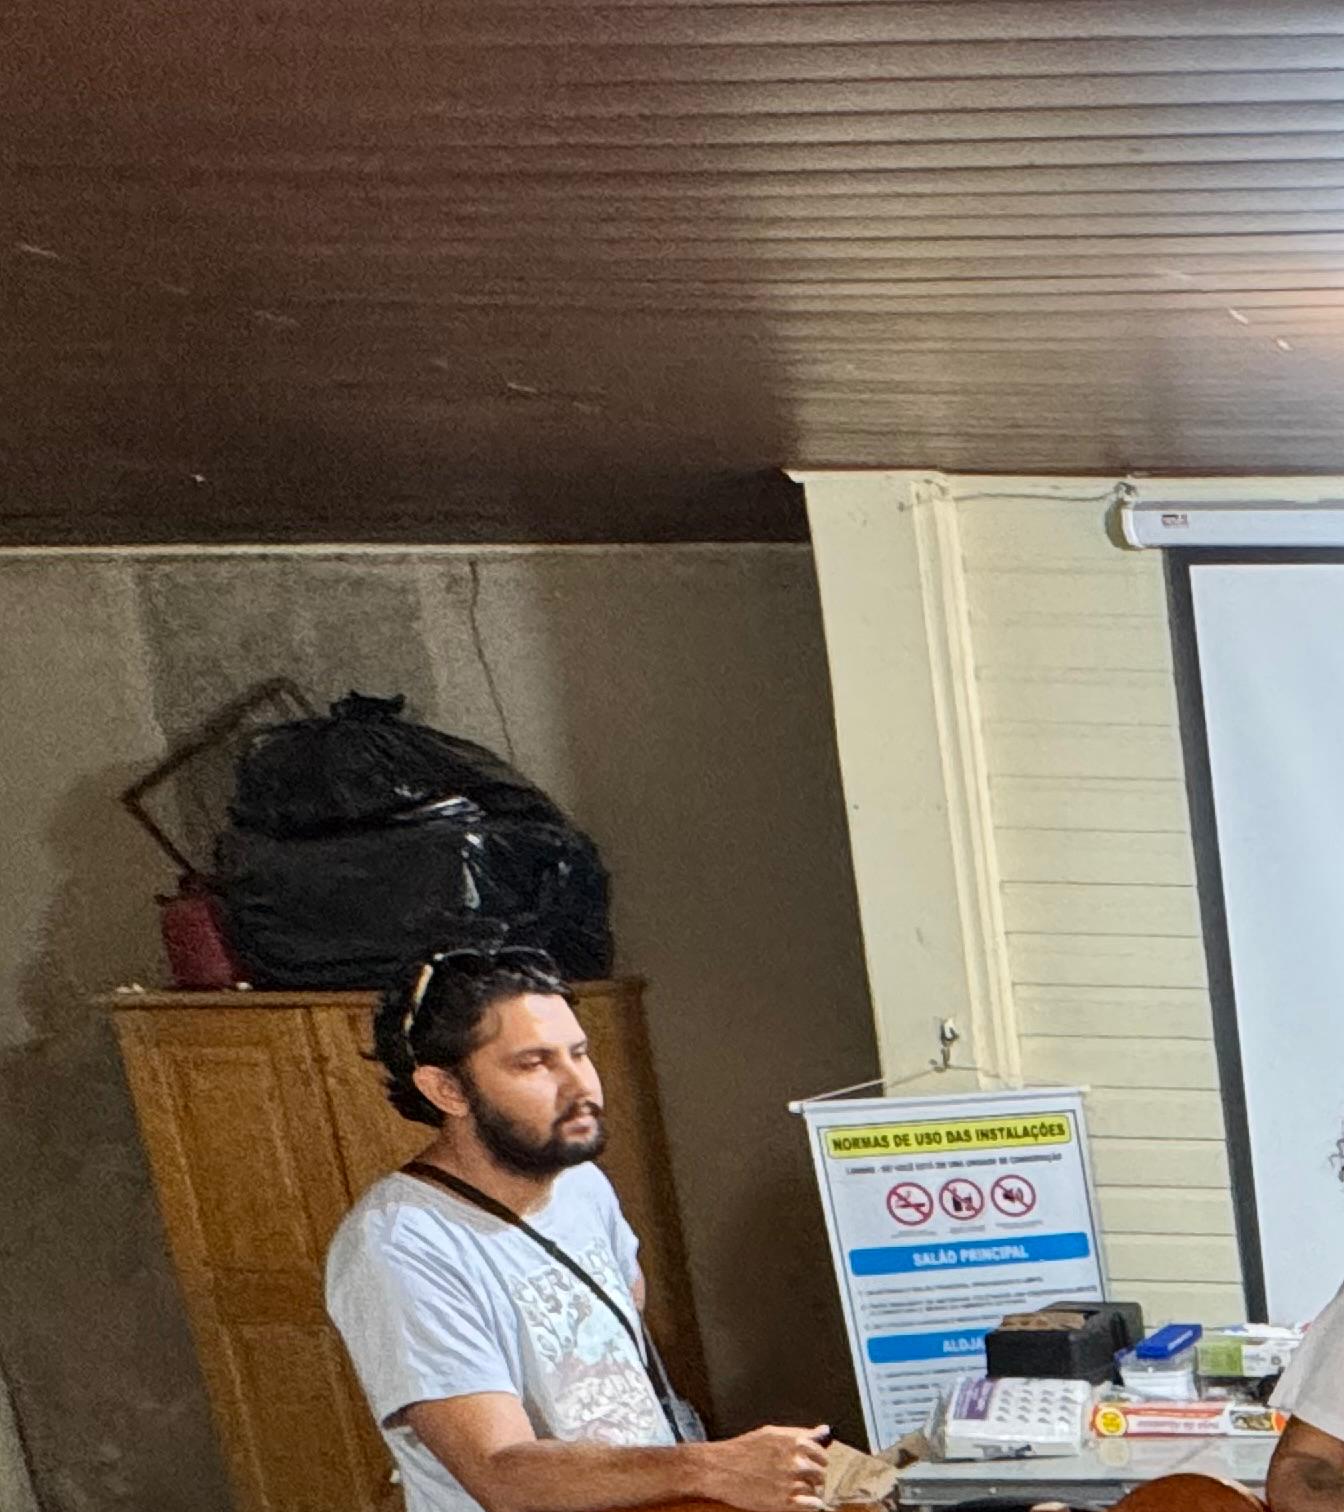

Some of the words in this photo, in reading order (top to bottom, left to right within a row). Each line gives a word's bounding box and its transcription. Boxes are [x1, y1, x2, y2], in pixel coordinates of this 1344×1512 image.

[832, 1134, 890, 1151] NORMAS
[892, 1133, 912, 1147] DE
[914, 1131, 942, 1146] USO
[945, 1129, 972, 1144] DAS
[975, 1121, 1066, 1142] INSTALAÇÕES
[912, 1248, 958, 1267] SALÃO
[960, 1244, 1030, 1263] PRINCIPAL
